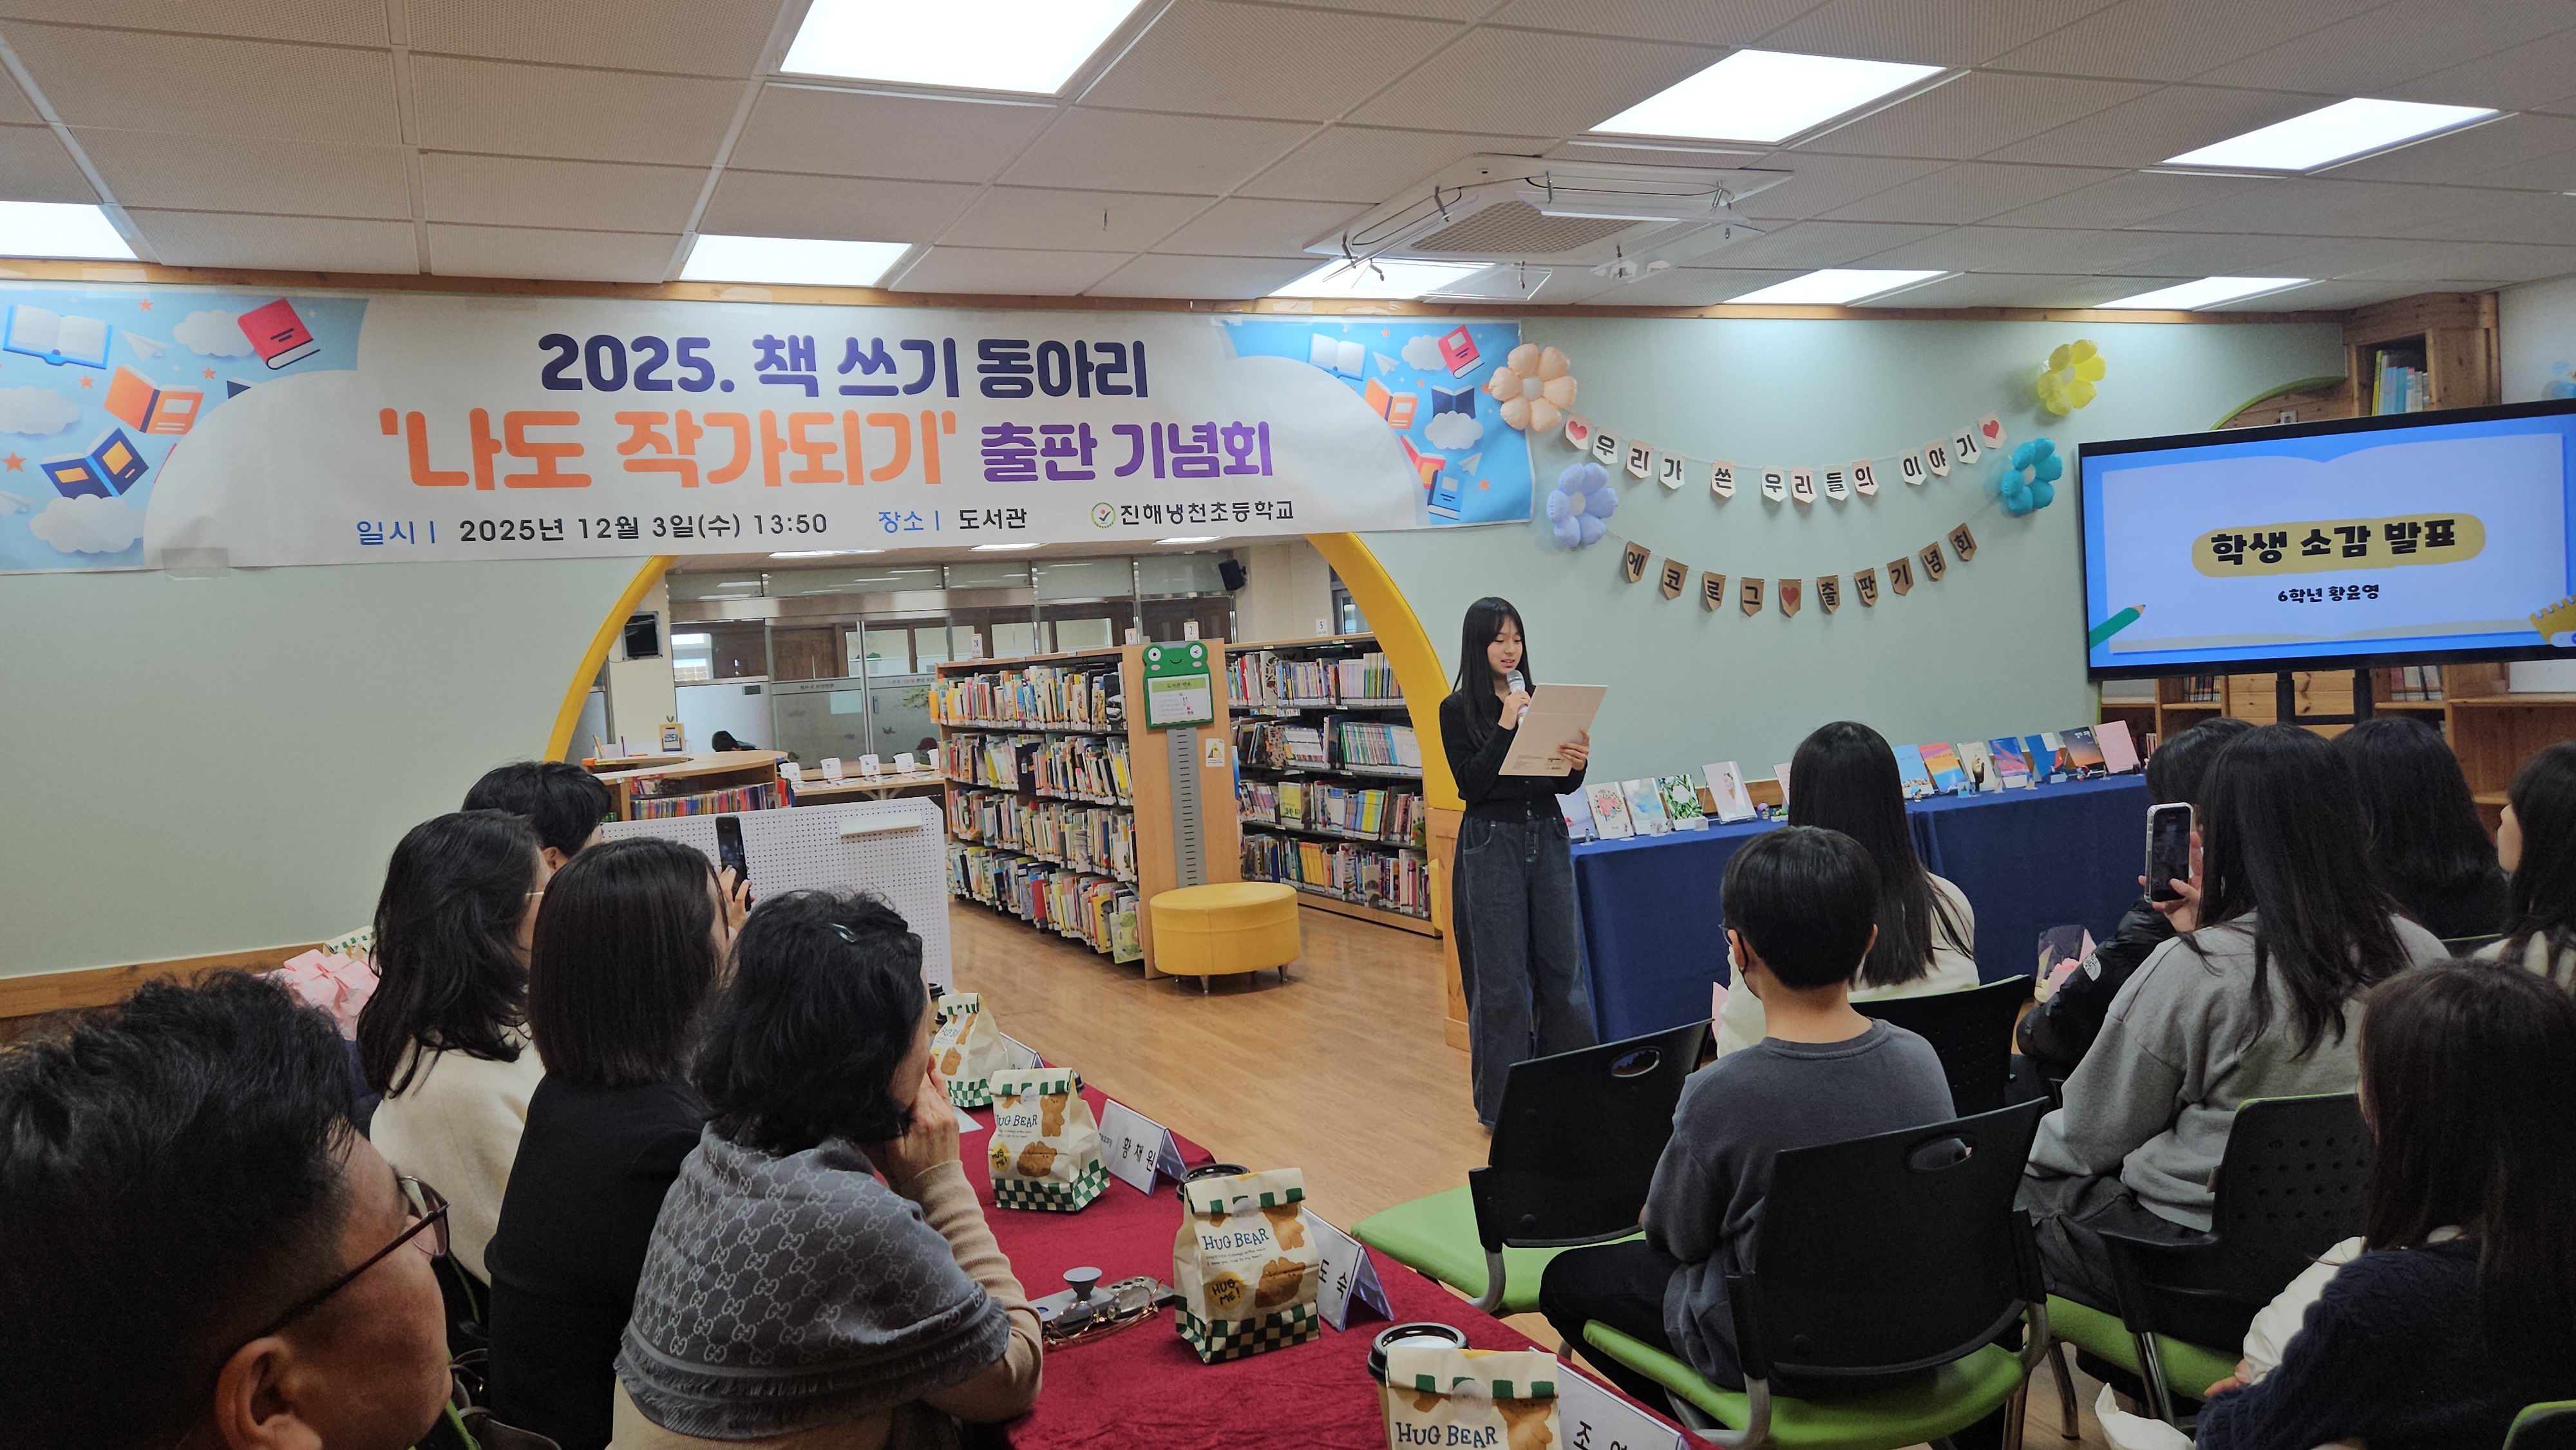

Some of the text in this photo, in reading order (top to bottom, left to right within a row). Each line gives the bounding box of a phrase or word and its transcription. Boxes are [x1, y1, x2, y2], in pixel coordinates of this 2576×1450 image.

[538, 334, 1148, 399] 2025. 책 쓰기 동아리
[379, 408, 1273, 491] '나도 작가되기' 출판 기념회
[1596, 435, 1681, 480] 우리가
[1714, 467, 1732, 489] 쓴
[1903, 434, 1976, 476] 이야기
[878, 511, 924, 534] 장소
[959, 508, 1027, 530] 도서관
[1121, 500, 1294, 525] 진해냉천초등학교
[356, 521, 415, 545] 일시
[459, 518, 564, 542] 2025년
[578, 516, 639, 540] 12월
[652, 513, 740, 540] 3일(수)
[753, 513, 827, 534] 13:50
[2211, 518, 2456, 565] 학생 소감 발표
[2277, 584, 2380, 603] 6학년 황윤영
[1012, 1115, 1037, 1128] BEAR
[1202, 1228, 1269, 1250] HUG BEAR
[1212, 1279, 1235, 1295] HUG
[1220, 1287, 1241, 1306] ME!
[1396, 1422, 1499, 1448] HUG BEAR
